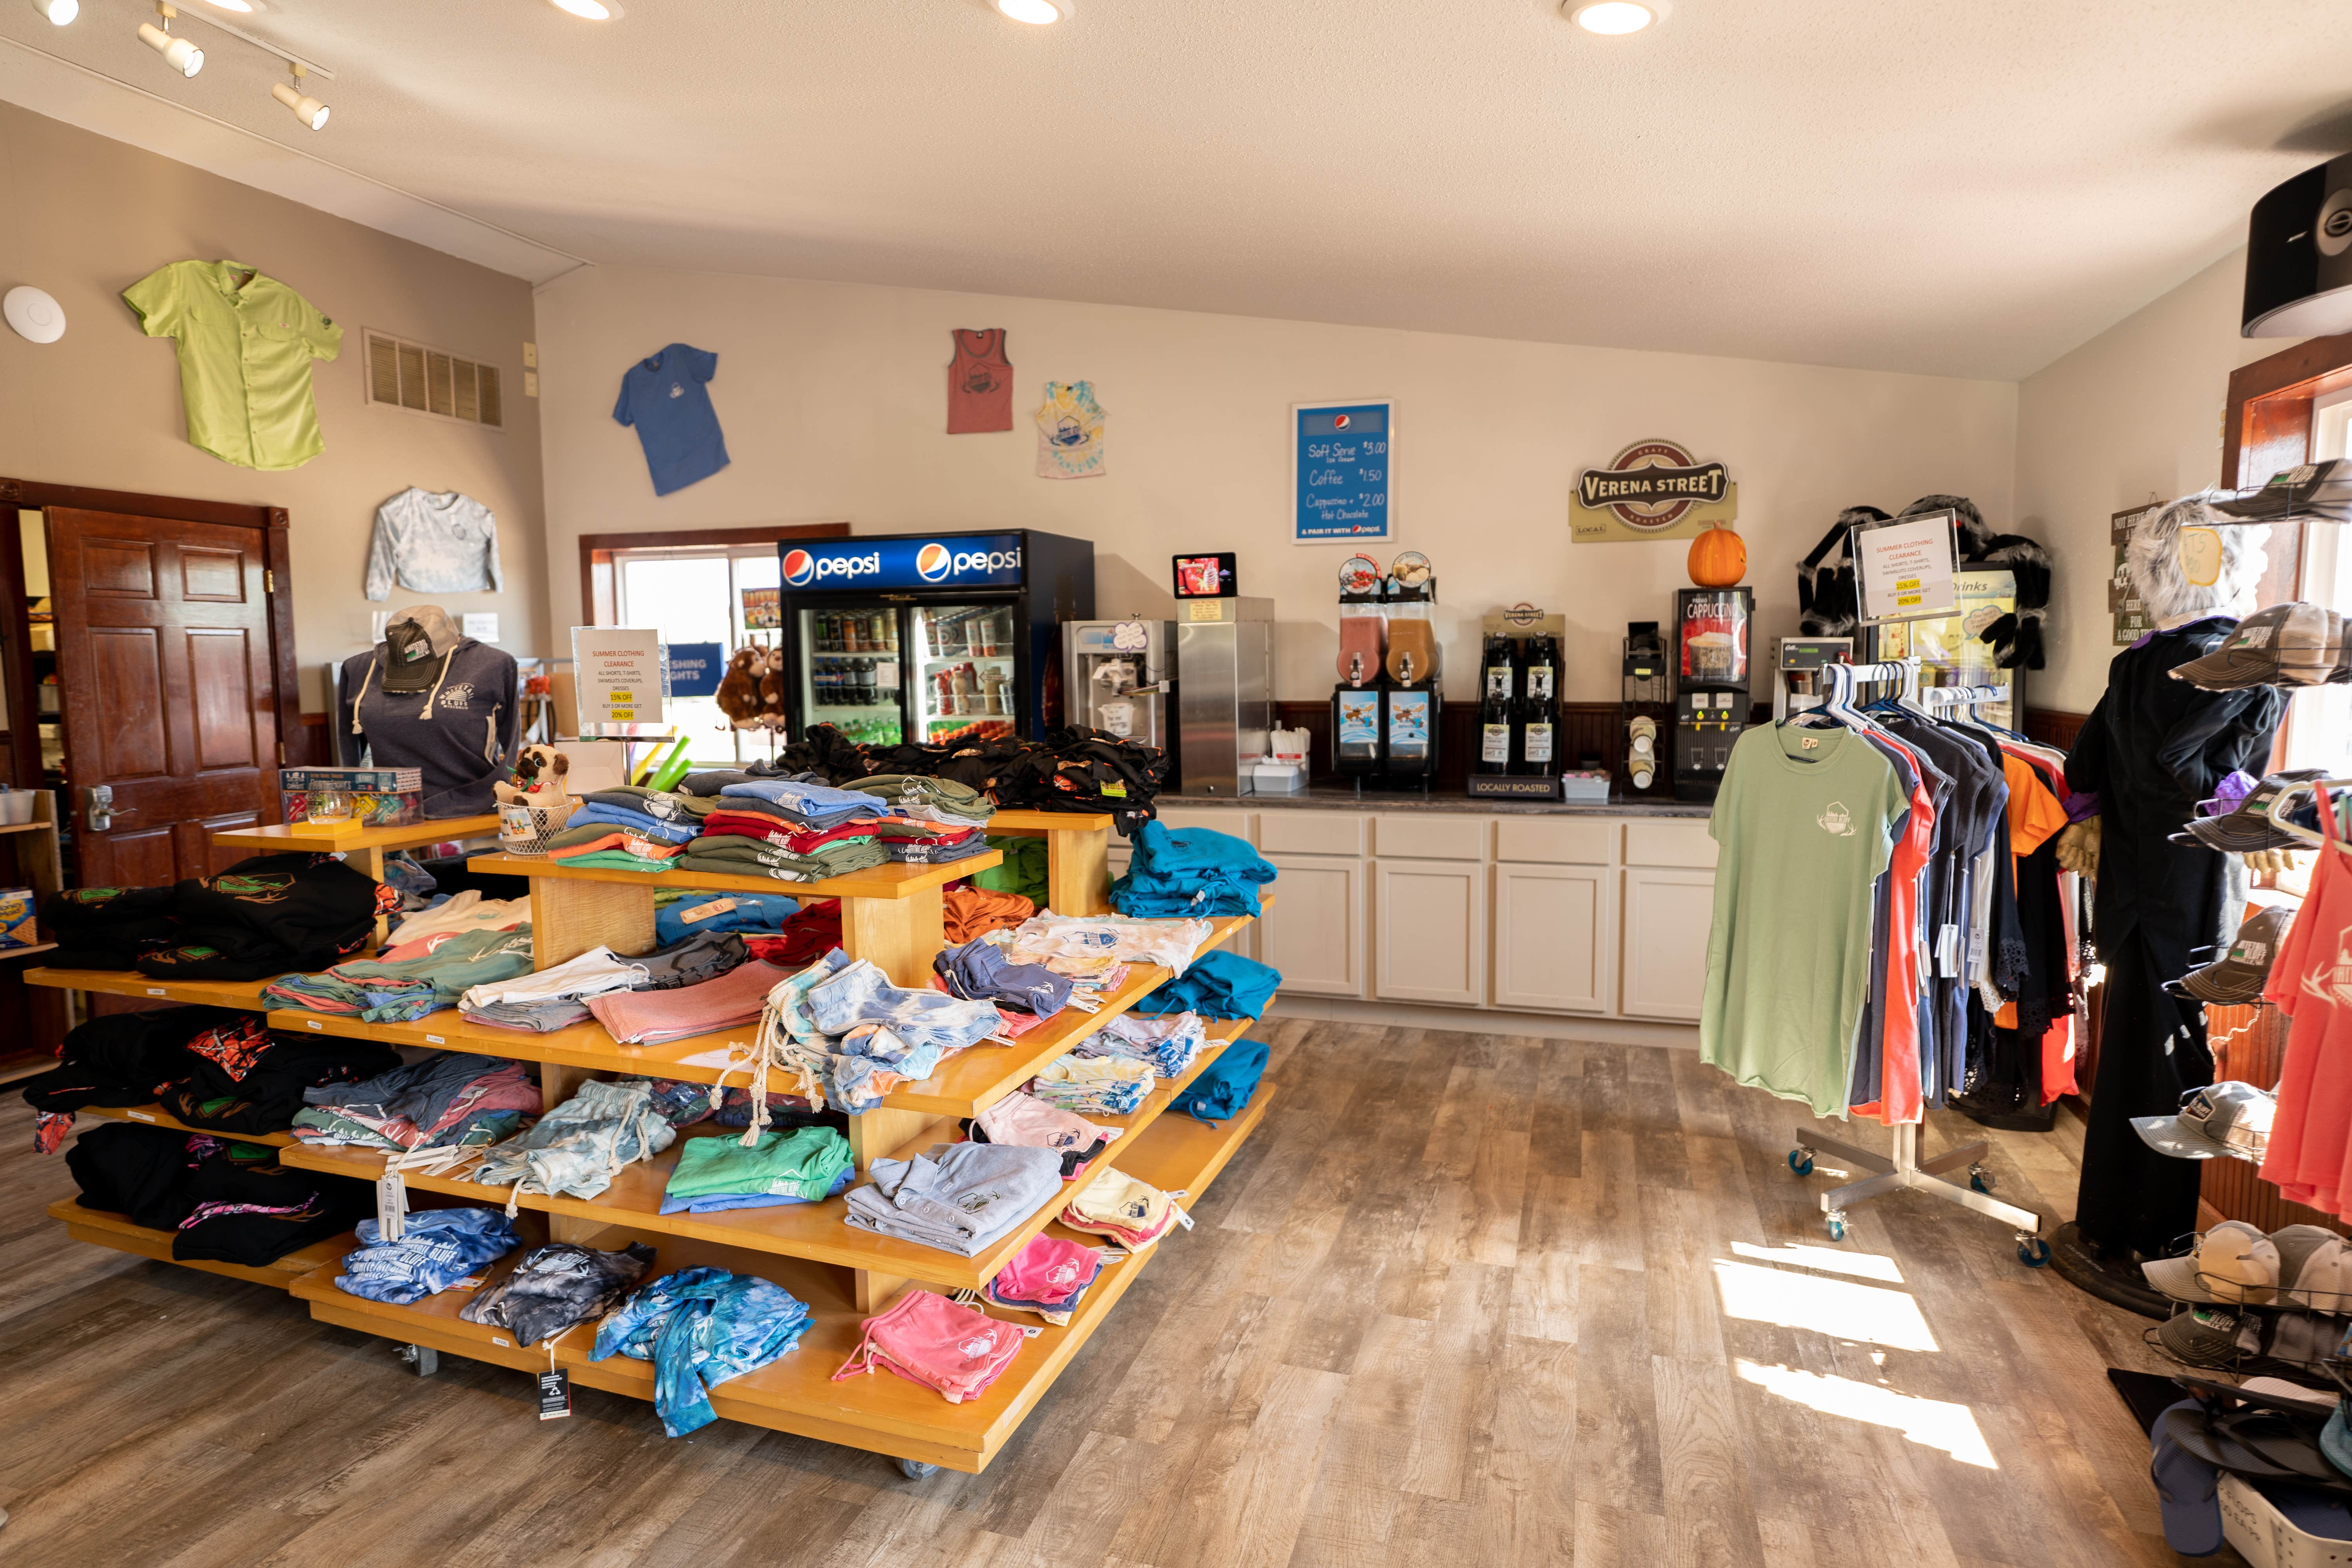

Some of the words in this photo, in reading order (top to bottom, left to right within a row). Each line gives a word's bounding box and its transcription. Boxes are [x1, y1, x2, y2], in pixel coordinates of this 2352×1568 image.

[1308, 444, 1329, 457] Soft
[1332, 443, 1356, 457] Serve
[1309, 470, 1343, 486] Coffee
[1584, 476, 1651, 500] VERENA
[1657, 469, 1722, 495] STREET
[1321, 510, 1334, 520] Hot
[2114, 516, 2127, 531] NOT
[1877, 544, 1902, 553] SUMMER
[1904, 539, 1933, 548] CLOTHING
[1889, 550, 1922, 560] CLEARANCE
[816, 552, 880, 580] pepsi
[953, 547, 1021, 575] pepsi
[2125, 599, 2141, 612] HERE
[1504, 610, 1524, 620] VERENA
[1524, 609, 1543, 619] STREET
[2130, 615, 2142, 628] FOR
[2117, 630, 2122, 641] A
[2122, 629, 2139, 641] GOOD
[670, 659, 707, 669] SHING
[670, 670, 700, 680] GHTS
[1477, 783, 1510, 793] LOCALLY
[1513, 784, 1550, 793] ROASTED
[400, 1250, 430, 1267] BLUFF
[431, 1246, 458, 1263] BLUFF
[2209, 1315, 2236, 1327] BLUFF
